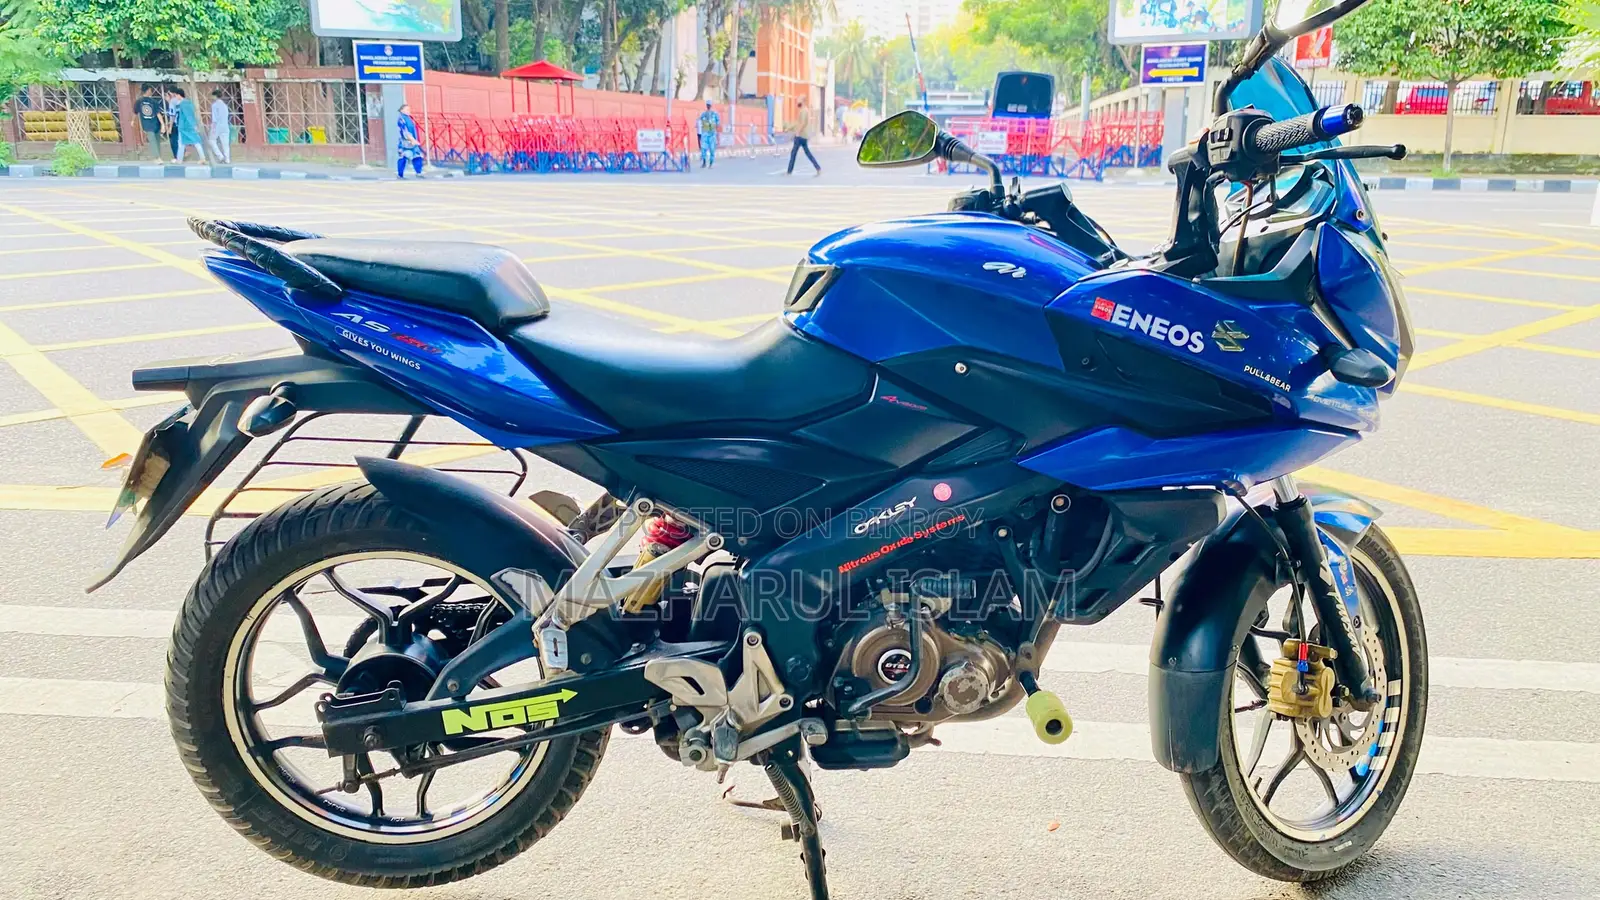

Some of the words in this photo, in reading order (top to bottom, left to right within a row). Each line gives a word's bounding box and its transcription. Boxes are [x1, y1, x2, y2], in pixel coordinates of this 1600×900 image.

[1112, 304, 1205, 353] ENEOS
[342, 329, 369, 347] GIVES
[370, 342, 389, 356] YOU
[390, 351, 421, 371] WINGS
[1243, 365, 1292, 392] PULL&BEAR
[854, 496, 917, 534] OAKLEY
[838, 552, 881, 574] Nitrous
[880, 535, 914, 554] Oxide
[913, 514, 966, 539] Systems
[441, 700, 560, 735] NOS
